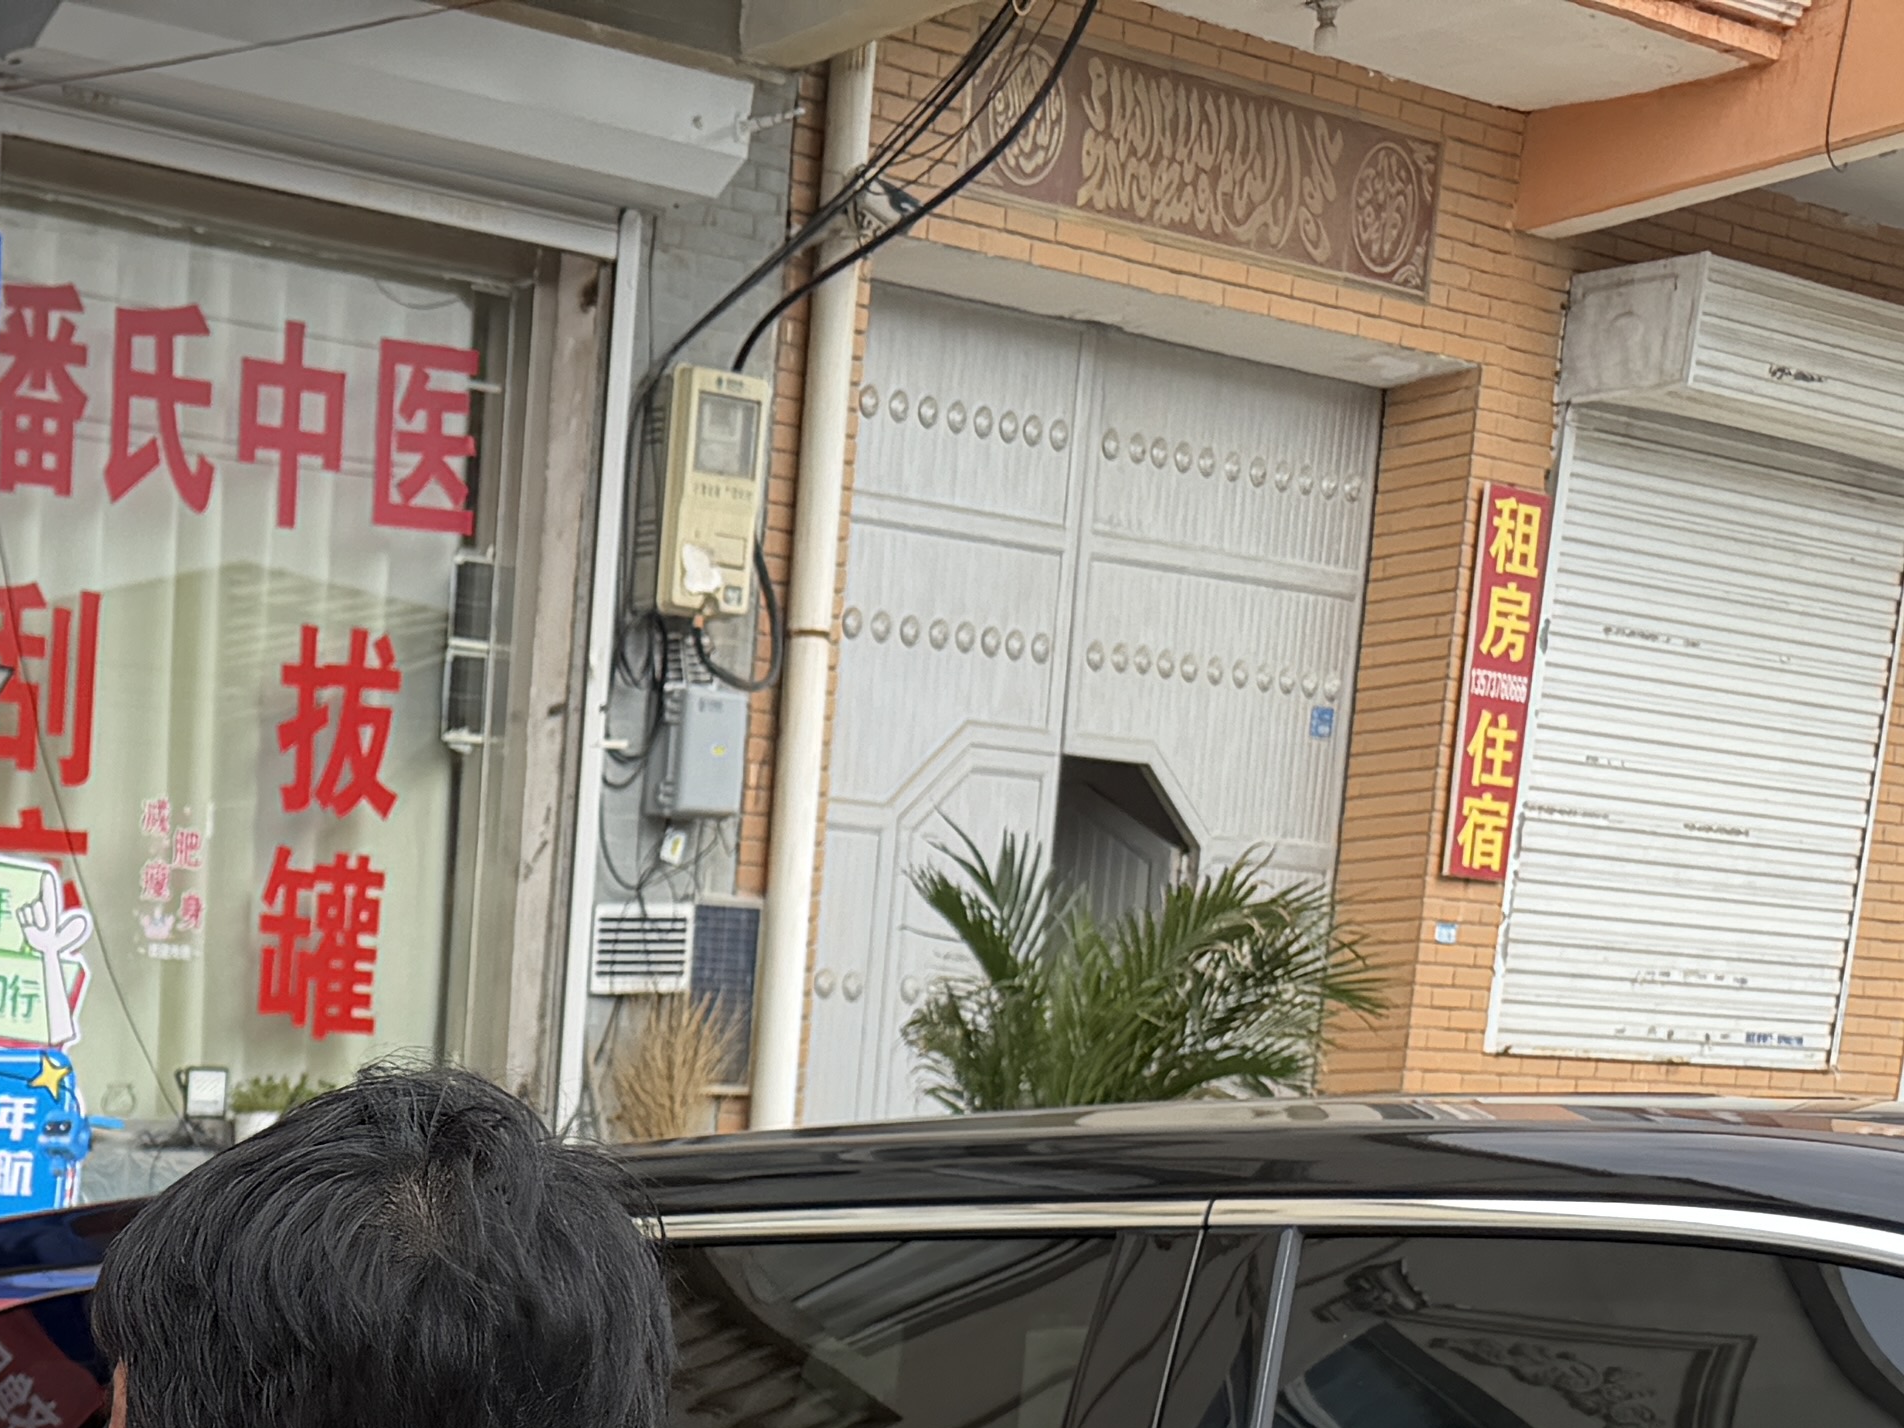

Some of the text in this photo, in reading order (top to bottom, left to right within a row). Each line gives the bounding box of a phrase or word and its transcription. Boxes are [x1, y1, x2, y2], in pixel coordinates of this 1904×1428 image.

[1479, 497, 1542, 662] 租房
[256, 624, 403, 1039] 拔罐
[1457, 709, 1518, 871] 住宿
